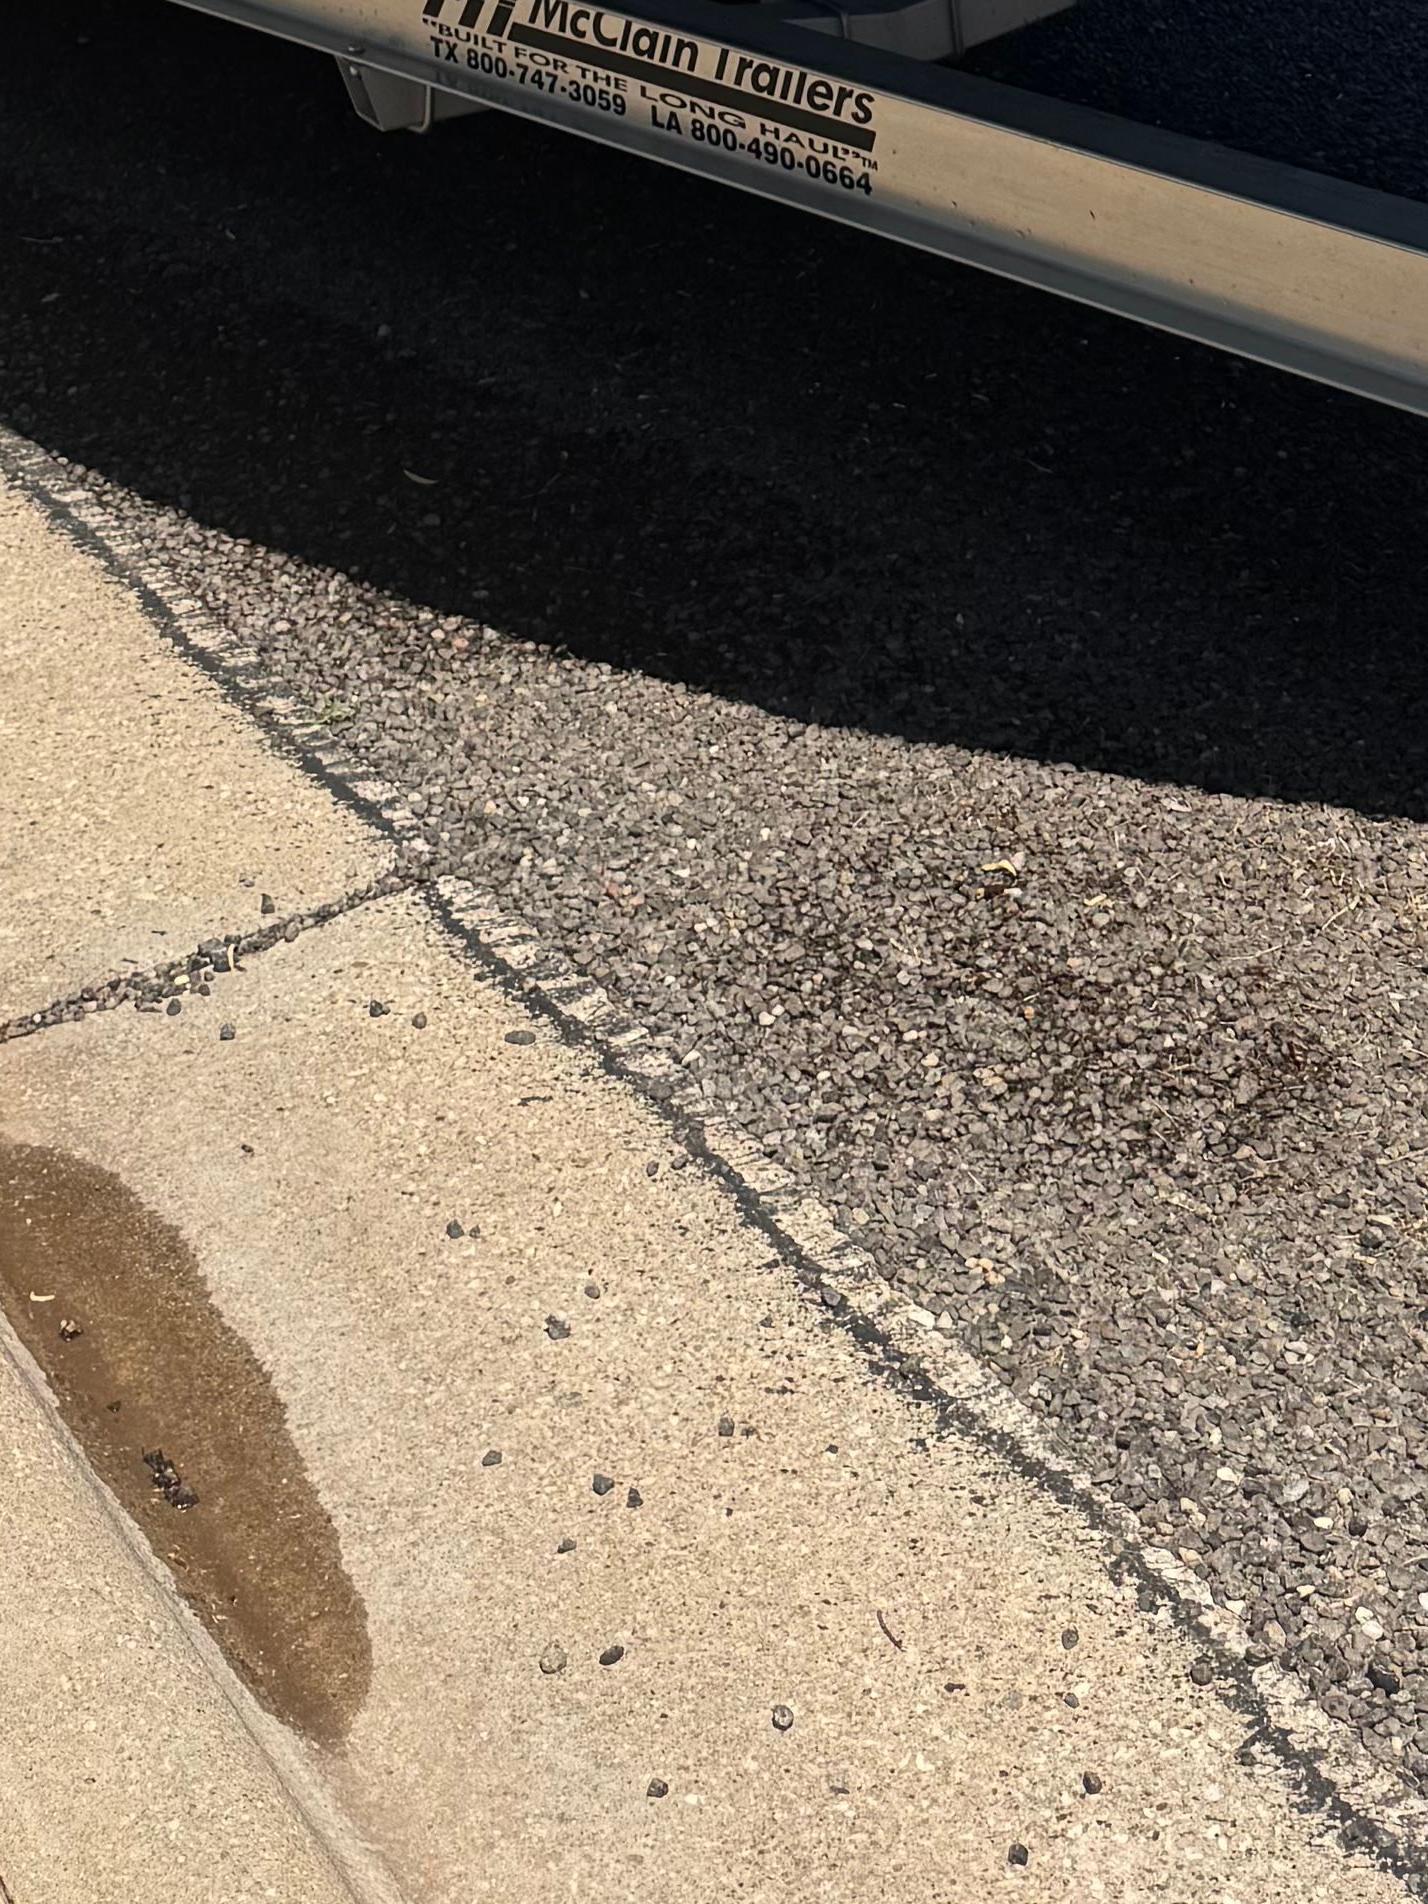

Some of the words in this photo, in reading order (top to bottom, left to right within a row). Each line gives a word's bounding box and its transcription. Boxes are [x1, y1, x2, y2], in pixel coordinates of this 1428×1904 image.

[429, 36, 460, 64] TX
[651, 104, 683, 135] LA
[513, 46, 570, 74] FOR
[575, 65, 629, 92] THE
[640, 85, 747, 129] LONG
[714, 48, 875, 125] Trailers
